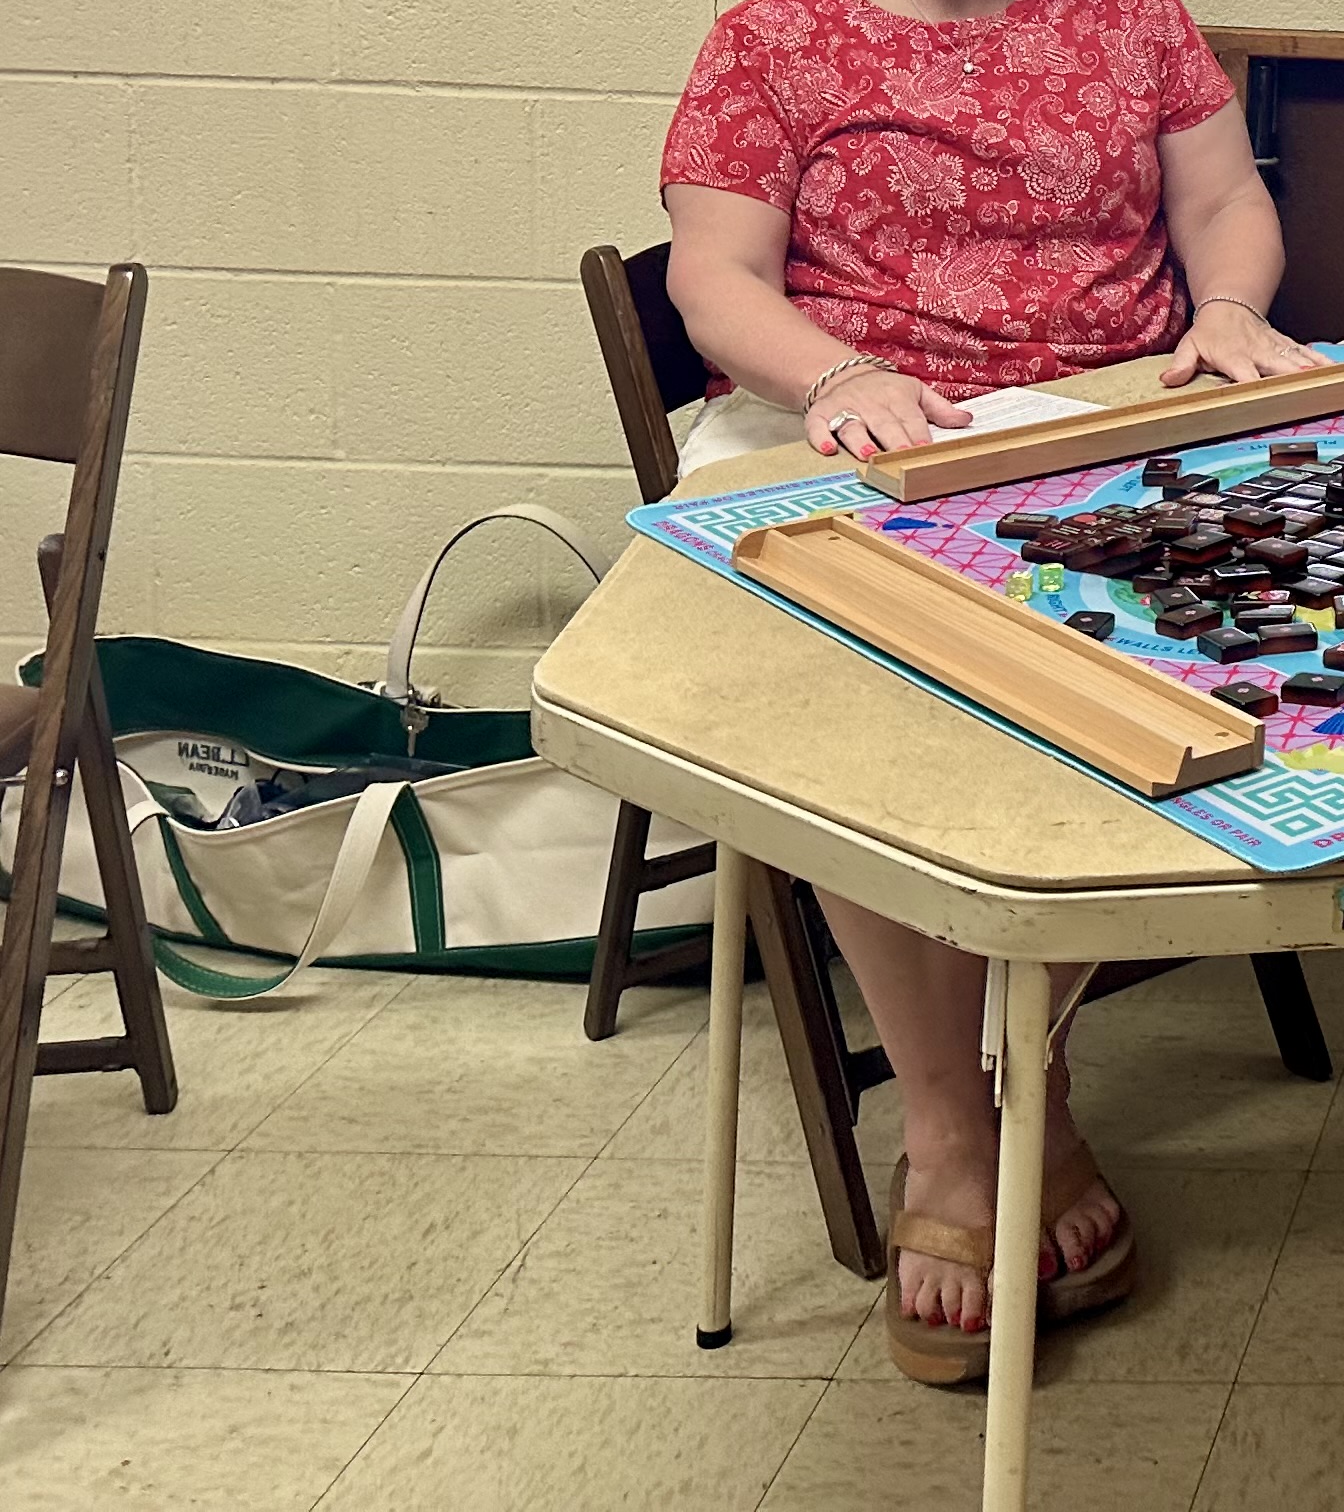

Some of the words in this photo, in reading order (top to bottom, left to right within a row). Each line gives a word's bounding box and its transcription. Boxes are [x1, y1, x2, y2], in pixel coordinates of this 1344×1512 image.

[1116, 637, 1173, 653] WALLS
[1178, 647, 1200, 656] LE
[1211, 818, 1232, 831] OR
[1229, 829, 1262, 848] PAIR
